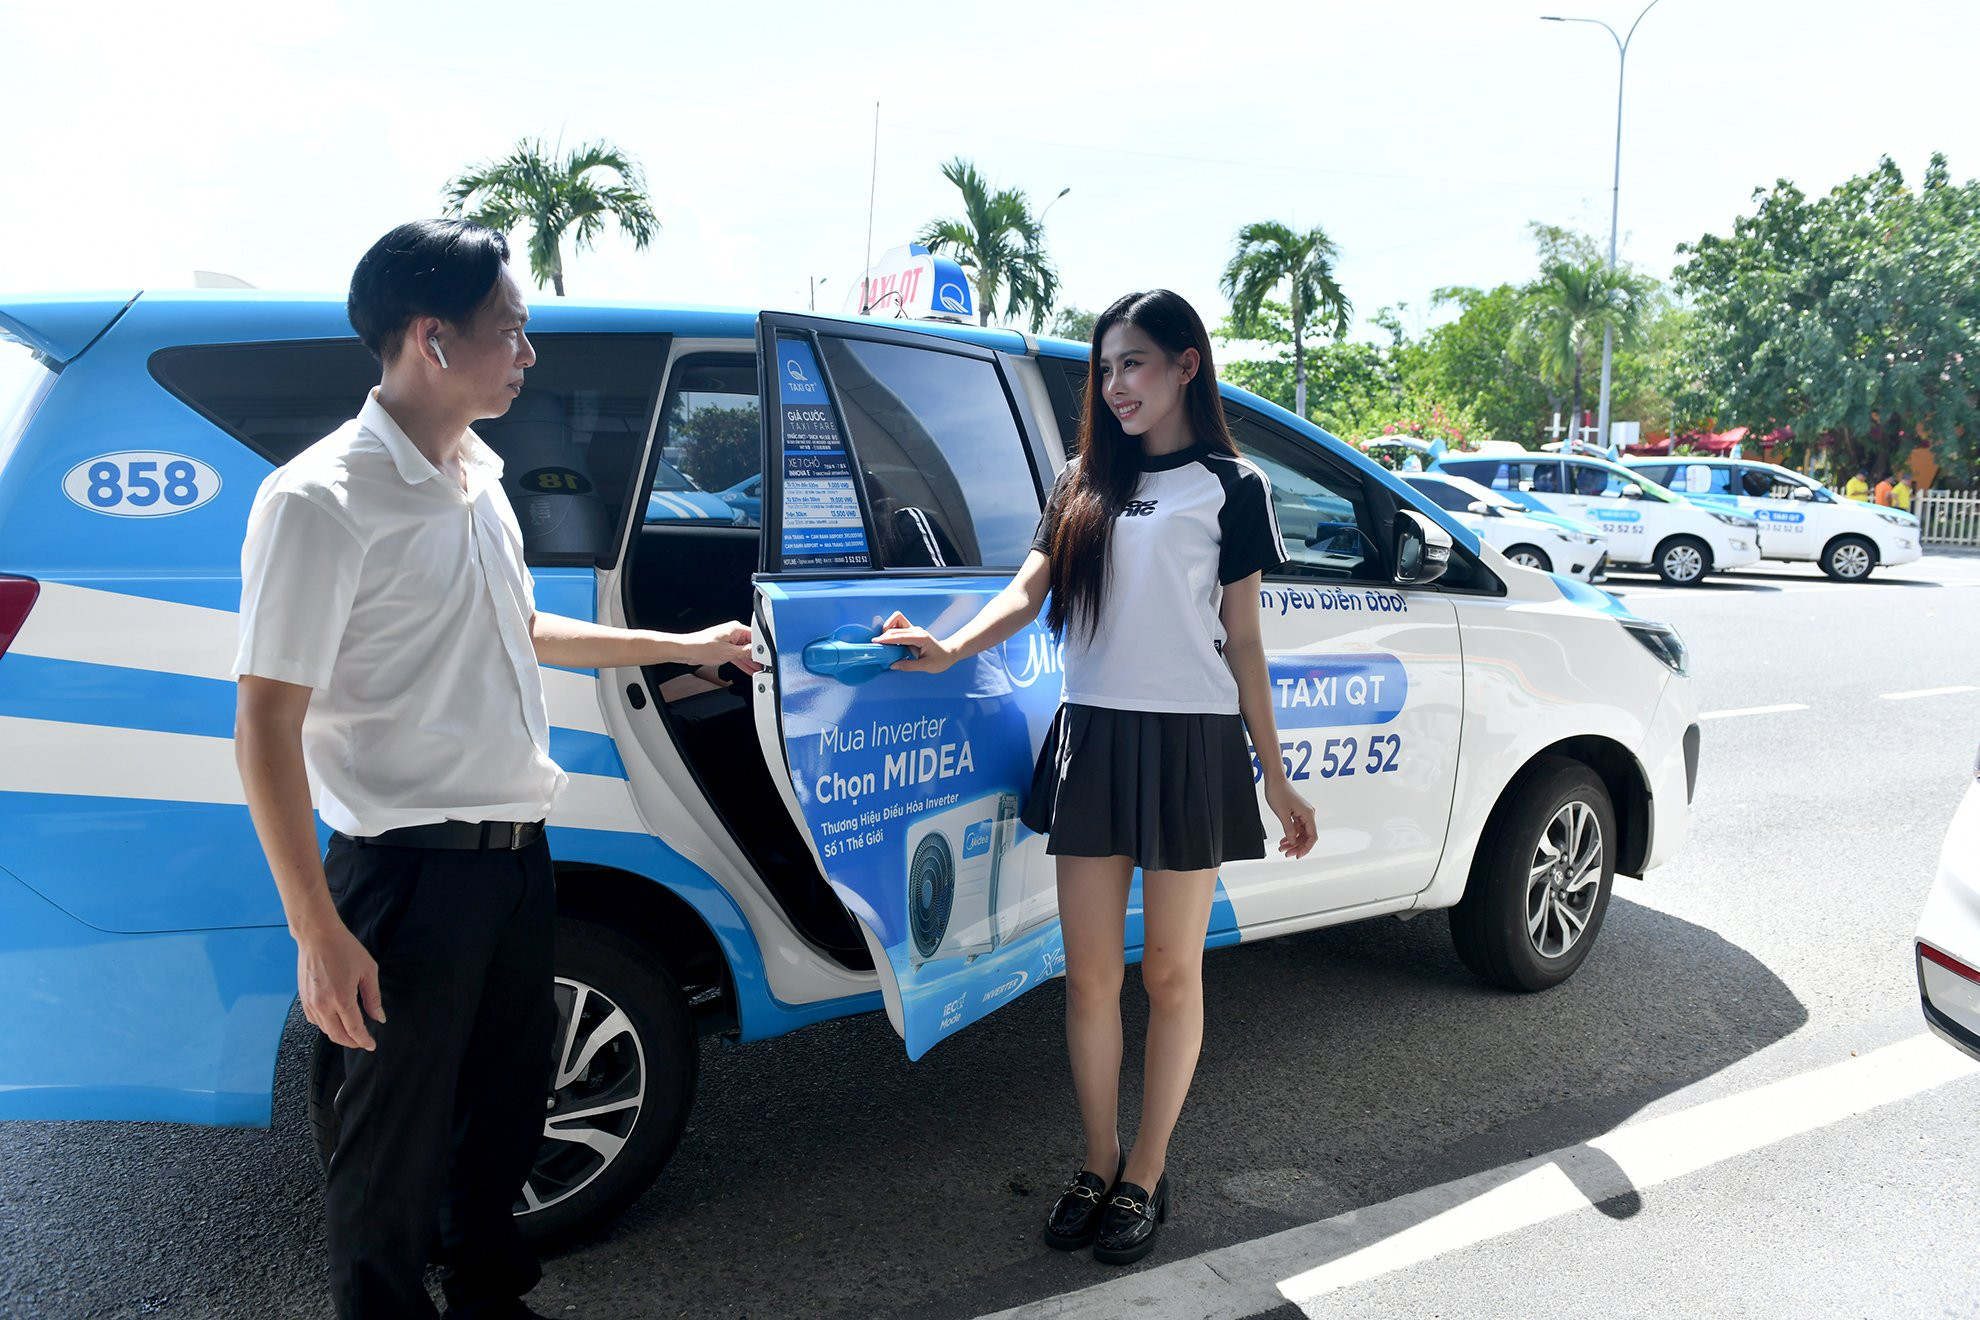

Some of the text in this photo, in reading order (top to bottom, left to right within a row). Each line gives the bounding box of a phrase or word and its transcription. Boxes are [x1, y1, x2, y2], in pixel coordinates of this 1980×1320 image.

[788, 382, 804, 392] TAXI
[787, 409, 826, 421] GIÁ CƯỚC
[790, 422, 836, 431] TAXI FARE
[87, 460, 199, 507] 858
[1277, 675, 1385, 709] TAXI QT
[819, 715, 947, 756] Mua Inverter
[815, 740, 975, 805] Chọn MIDEA
[1280, 740, 1312, 781] 52
[1320, 736, 1358, 779] 52
[1365, 733, 1401, 775] 52
[821, 792, 959, 836] Thương Hiệu Điều Hòa Inverter
[824, 828, 884, 858] Số 1 Thế Giới
[982, 978, 1019, 1003] INVERTER
[940, 1013, 961, 1031] Mode
